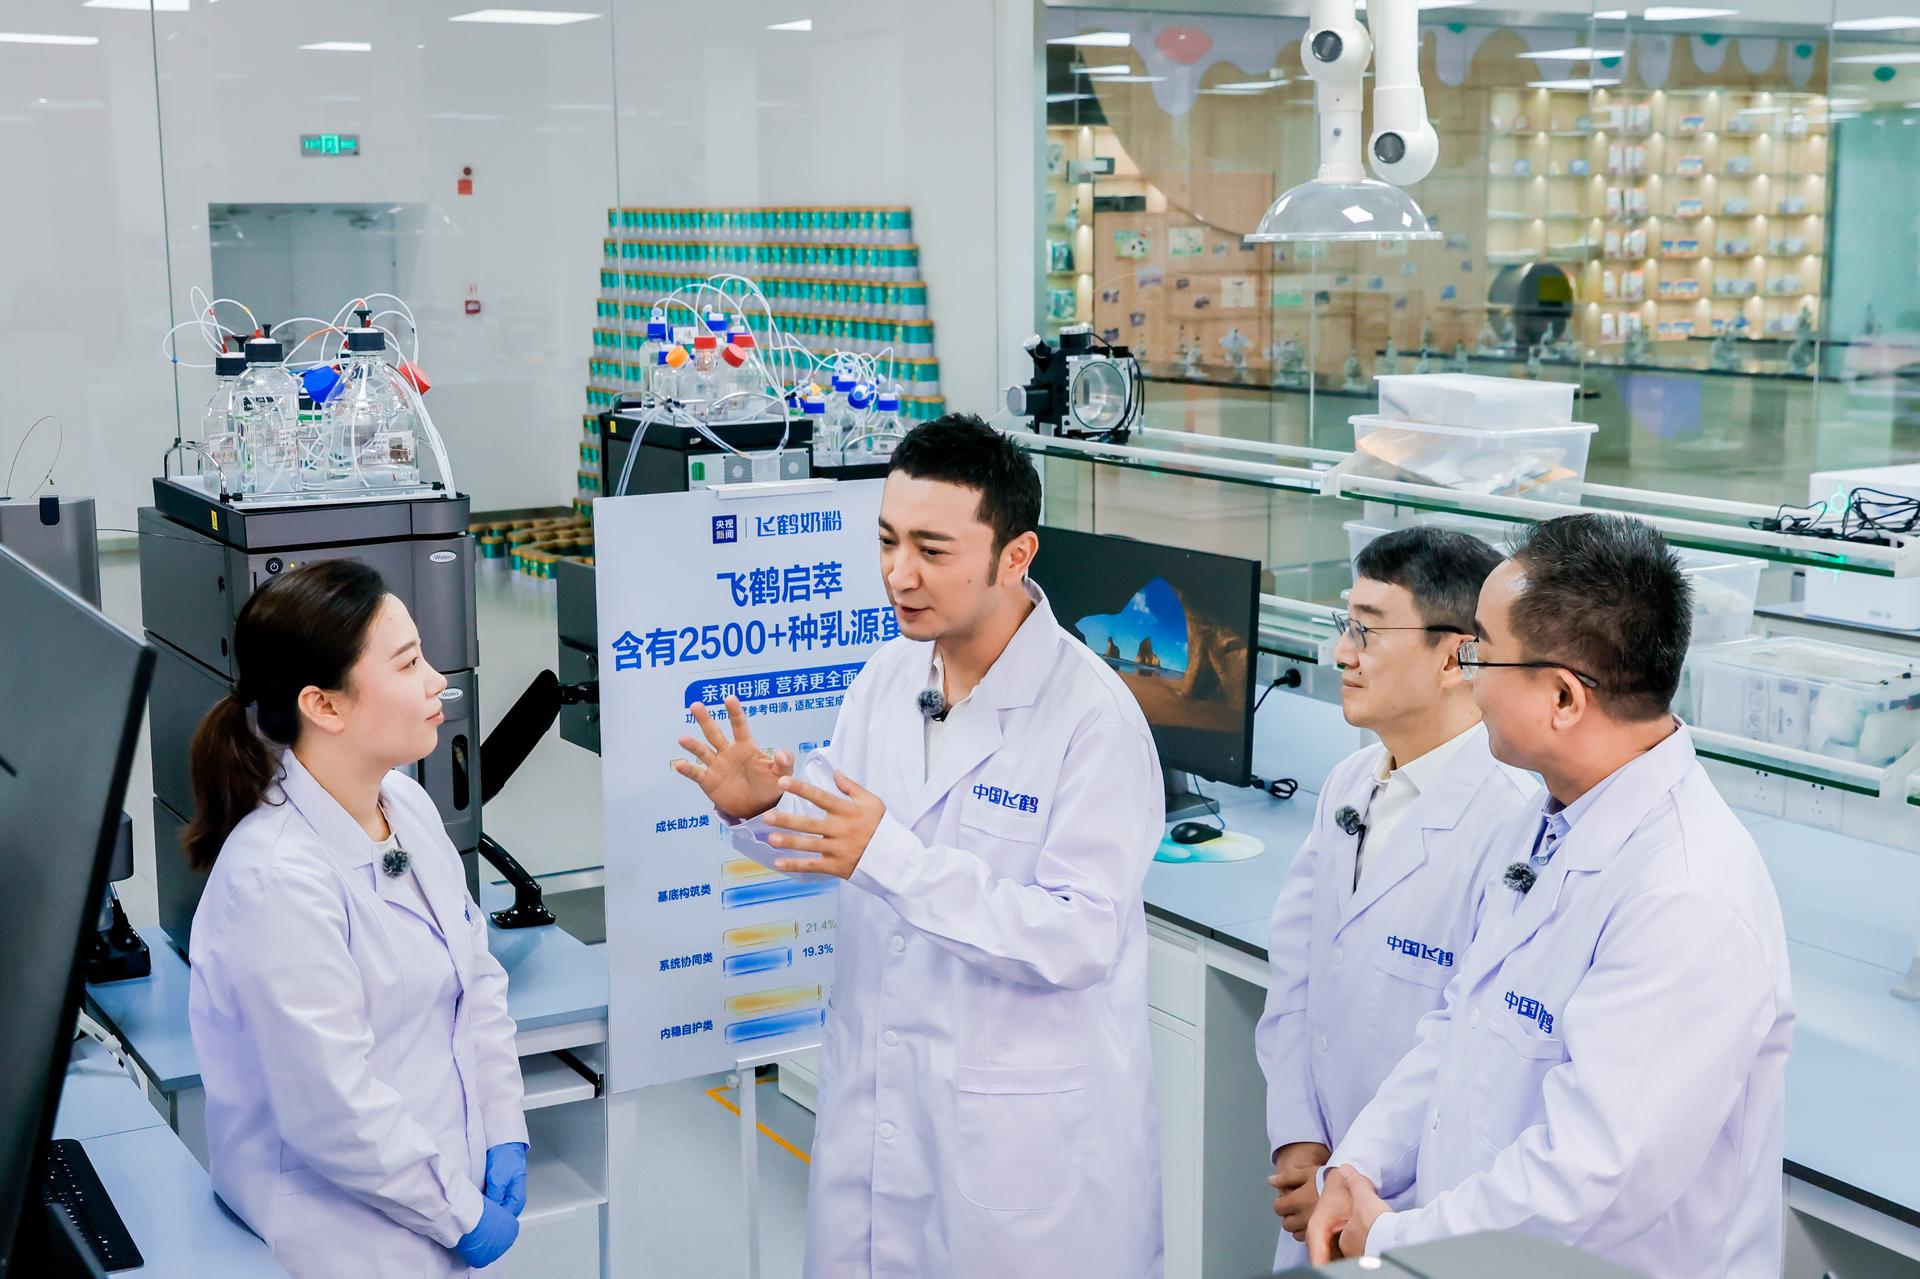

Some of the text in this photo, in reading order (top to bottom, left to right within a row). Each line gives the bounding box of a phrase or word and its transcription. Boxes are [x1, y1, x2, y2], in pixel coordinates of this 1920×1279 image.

[716, 519, 734, 530] 央视
[755, 510, 842, 537] 飞鹤奶粉
[716, 529, 734, 540] 新闻
[716, 561, 843, 607] 飞鹤启萃
[702, 668, 858, 703] 亲和母源 营养更全面
[973, 784, 1039, 813] 中国飞鹤
[656, 815, 710, 833] 成长助力类
[658, 884, 711, 902] 基底构筑类
[802, 944, 834, 957] 19.3%
[1387, 936, 1454, 966] 中国飞鹤
[659, 952, 713, 971] 系统协同类
[660, 1019, 713, 1040] 内稳自护类
